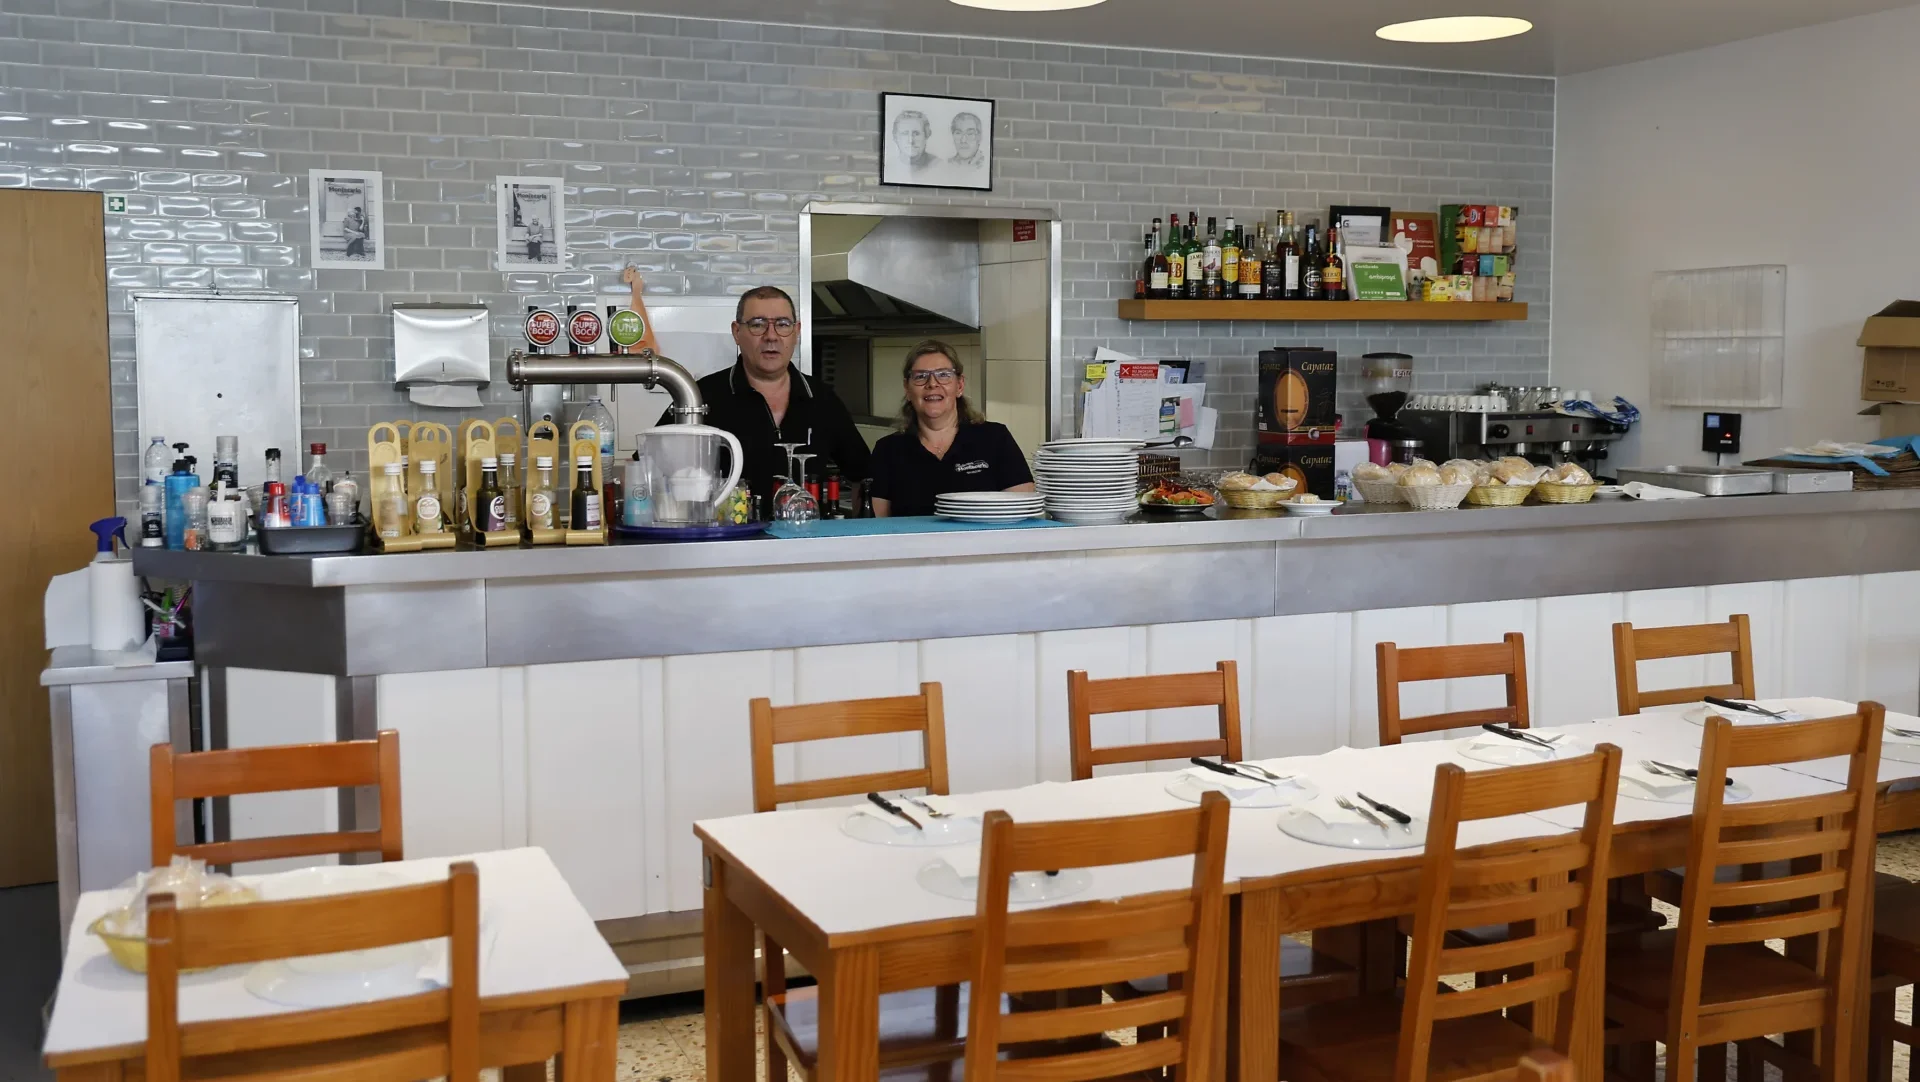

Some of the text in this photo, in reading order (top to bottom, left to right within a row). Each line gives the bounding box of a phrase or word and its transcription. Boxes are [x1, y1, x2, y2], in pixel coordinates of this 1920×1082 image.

[531, 320, 556, 329] SUPER
[574, 321, 598, 329] SUPER
[532, 327, 554, 336] BOCK
[575, 328, 597, 336] BOCK
[1301, 361, 1334, 375] Capataz
[1300, 455, 1333, 469] Capataz
